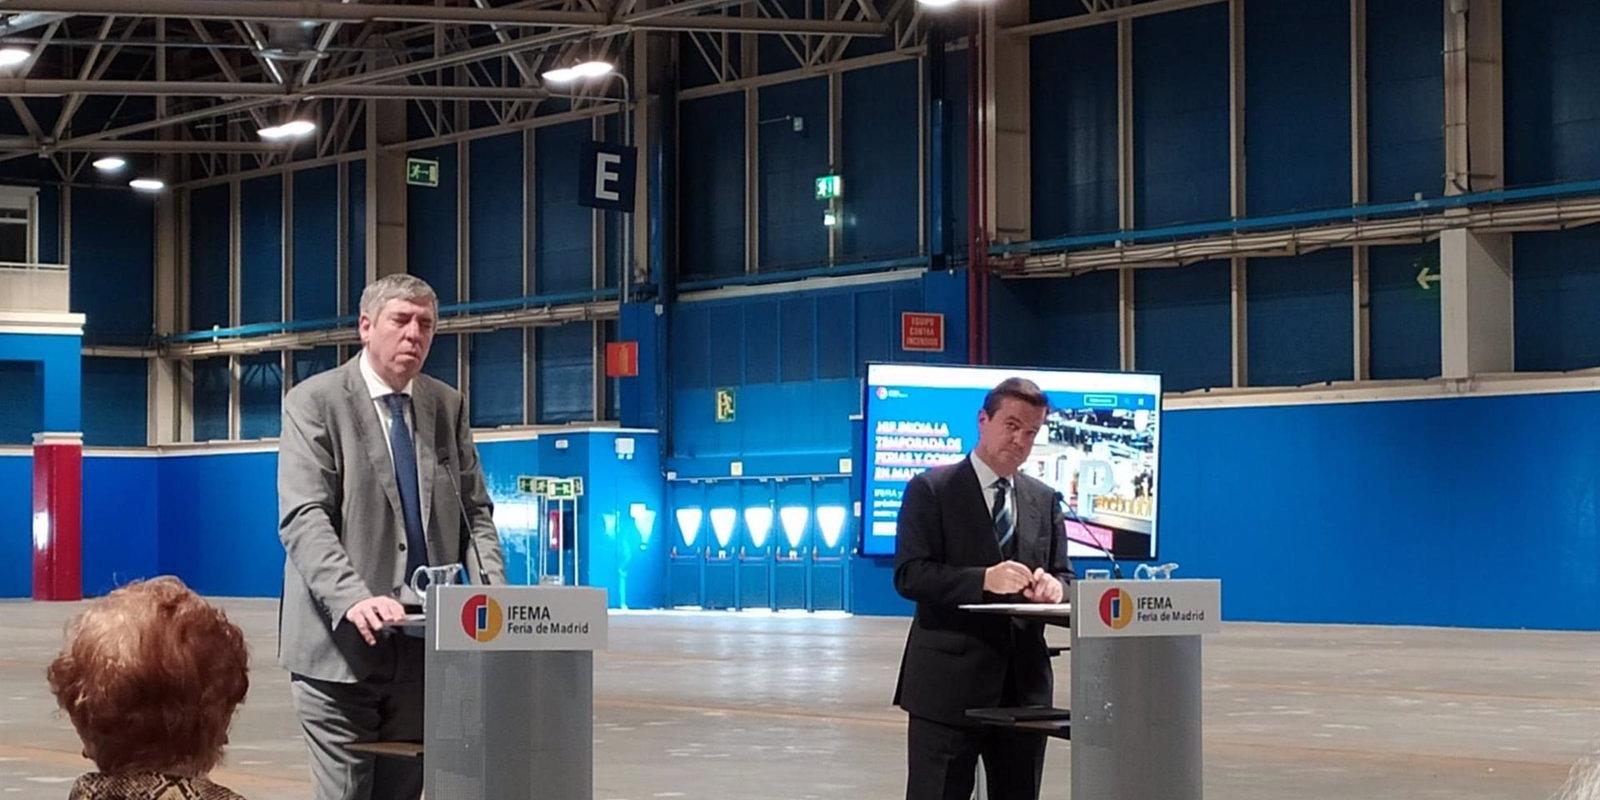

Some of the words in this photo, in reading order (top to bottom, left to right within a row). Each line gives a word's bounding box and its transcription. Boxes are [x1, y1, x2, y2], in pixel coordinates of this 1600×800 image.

[595, 152, 621, 201] E
[909, 326, 935, 336] CONTRA
[1137, 597, 1173, 610] IFEMA
[507, 605, 551, 621] IFEMA
[1137, 611, 1158, 622] Feria
[1160, 611, 1171, 622] de
[1172, 610, 1205, 622] Madrid
[507, 622, 533, 635] Feria
[535, 622, 549, 635] de
[550, 622, 589, 635] Madrid
